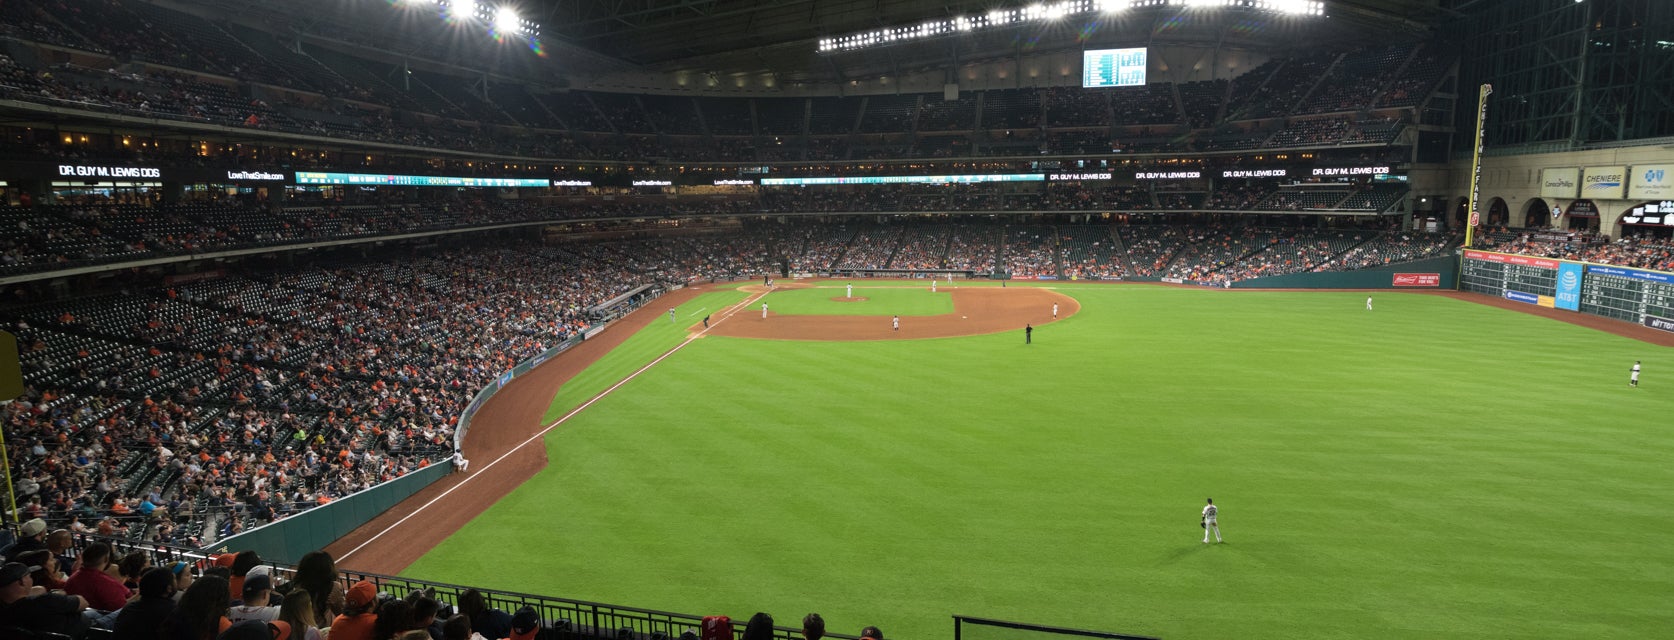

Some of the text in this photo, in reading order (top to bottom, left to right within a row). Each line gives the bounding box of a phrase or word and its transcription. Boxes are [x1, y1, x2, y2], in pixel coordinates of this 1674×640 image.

[59, 165, 160, 178] DR. GUY M. LEWIS DDS
[228, 171, 285, 180] LoveThatSmile.com
[1325, 168, 1341, 176] GUY
[1350, 167, 1373, 175] LEWIS
[1587, 175, 1622, 183] CHENIERE
[1545, 180, 1574, 188] ConocoPhillips
[1558, 292, 1577, 303] AT&T
